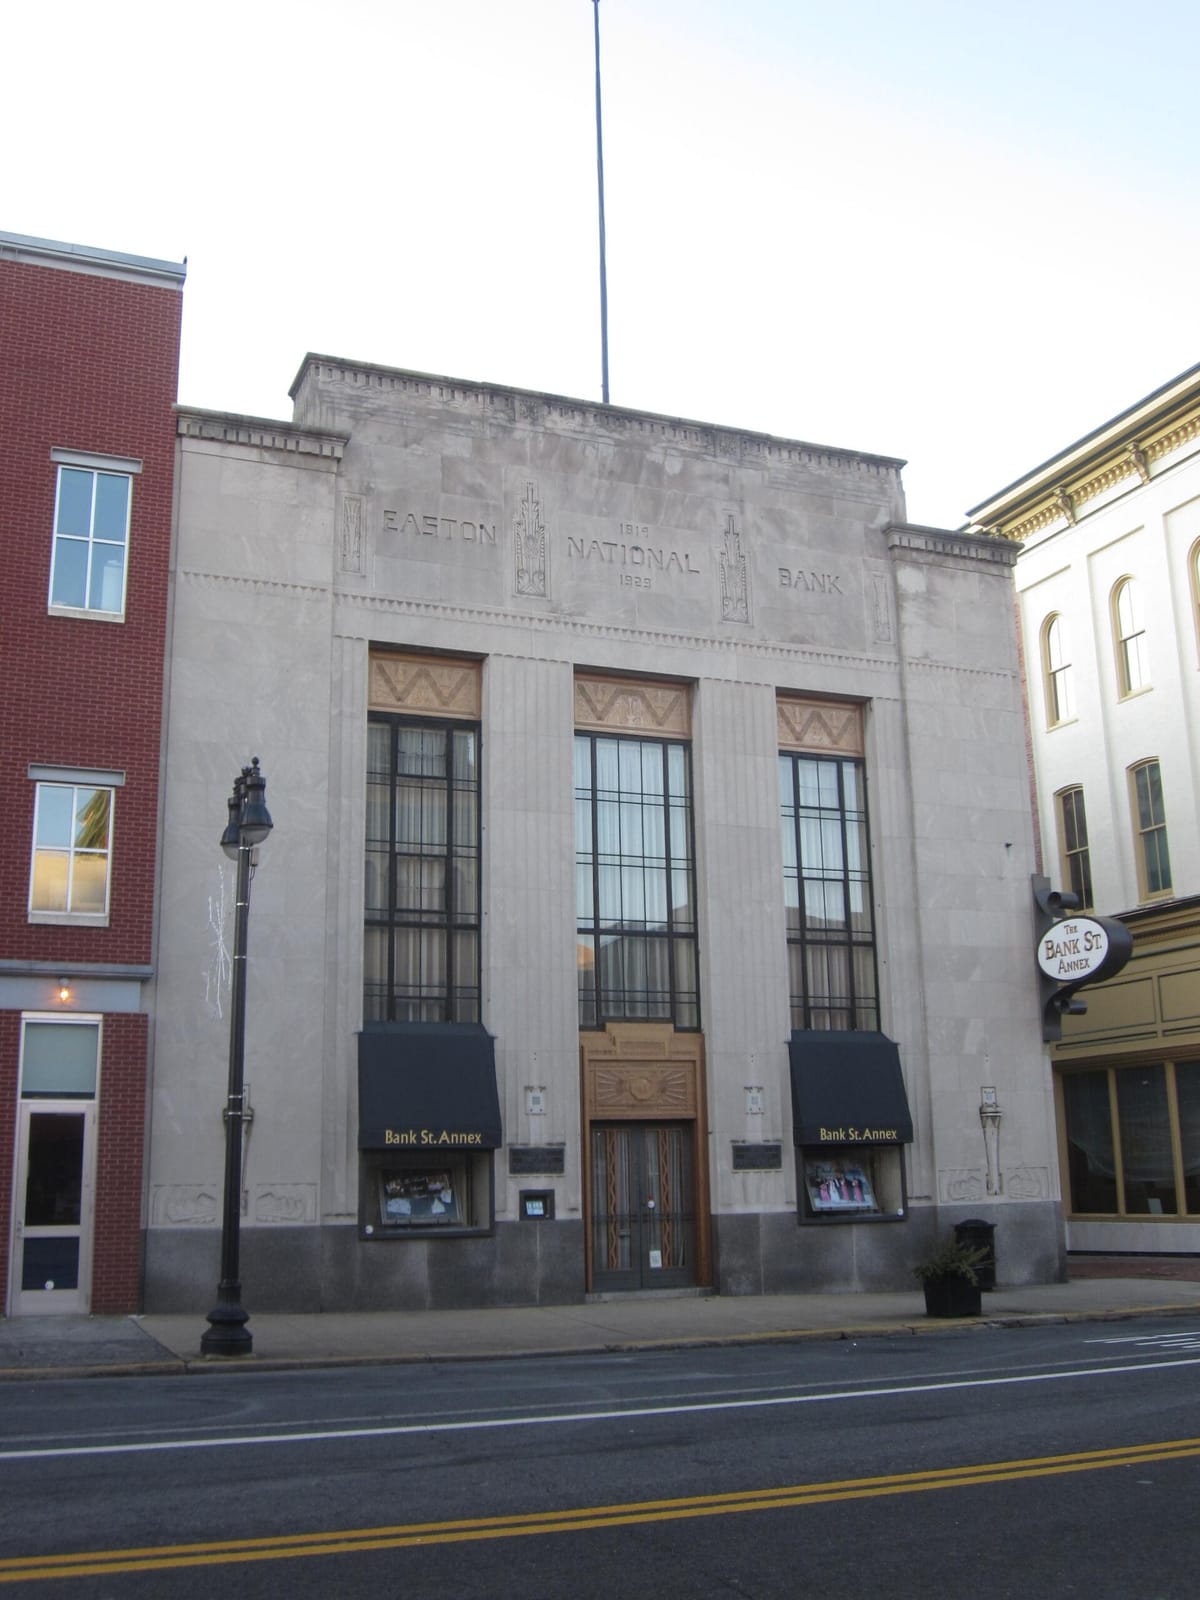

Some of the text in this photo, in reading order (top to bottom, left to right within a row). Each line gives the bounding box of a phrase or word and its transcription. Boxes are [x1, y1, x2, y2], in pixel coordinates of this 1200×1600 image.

[383, 510, 843, 594] EASTON NATIONAL BANK
[1044, 938, 1081, 961] BANK
[1058, 958, 1090, 975] ANNEX
[385, 1129, 482, 1144] Bank St. Annex
[820, 1127, 846, 1141] Bank
[863, 1127, 898, 1140] Annex
